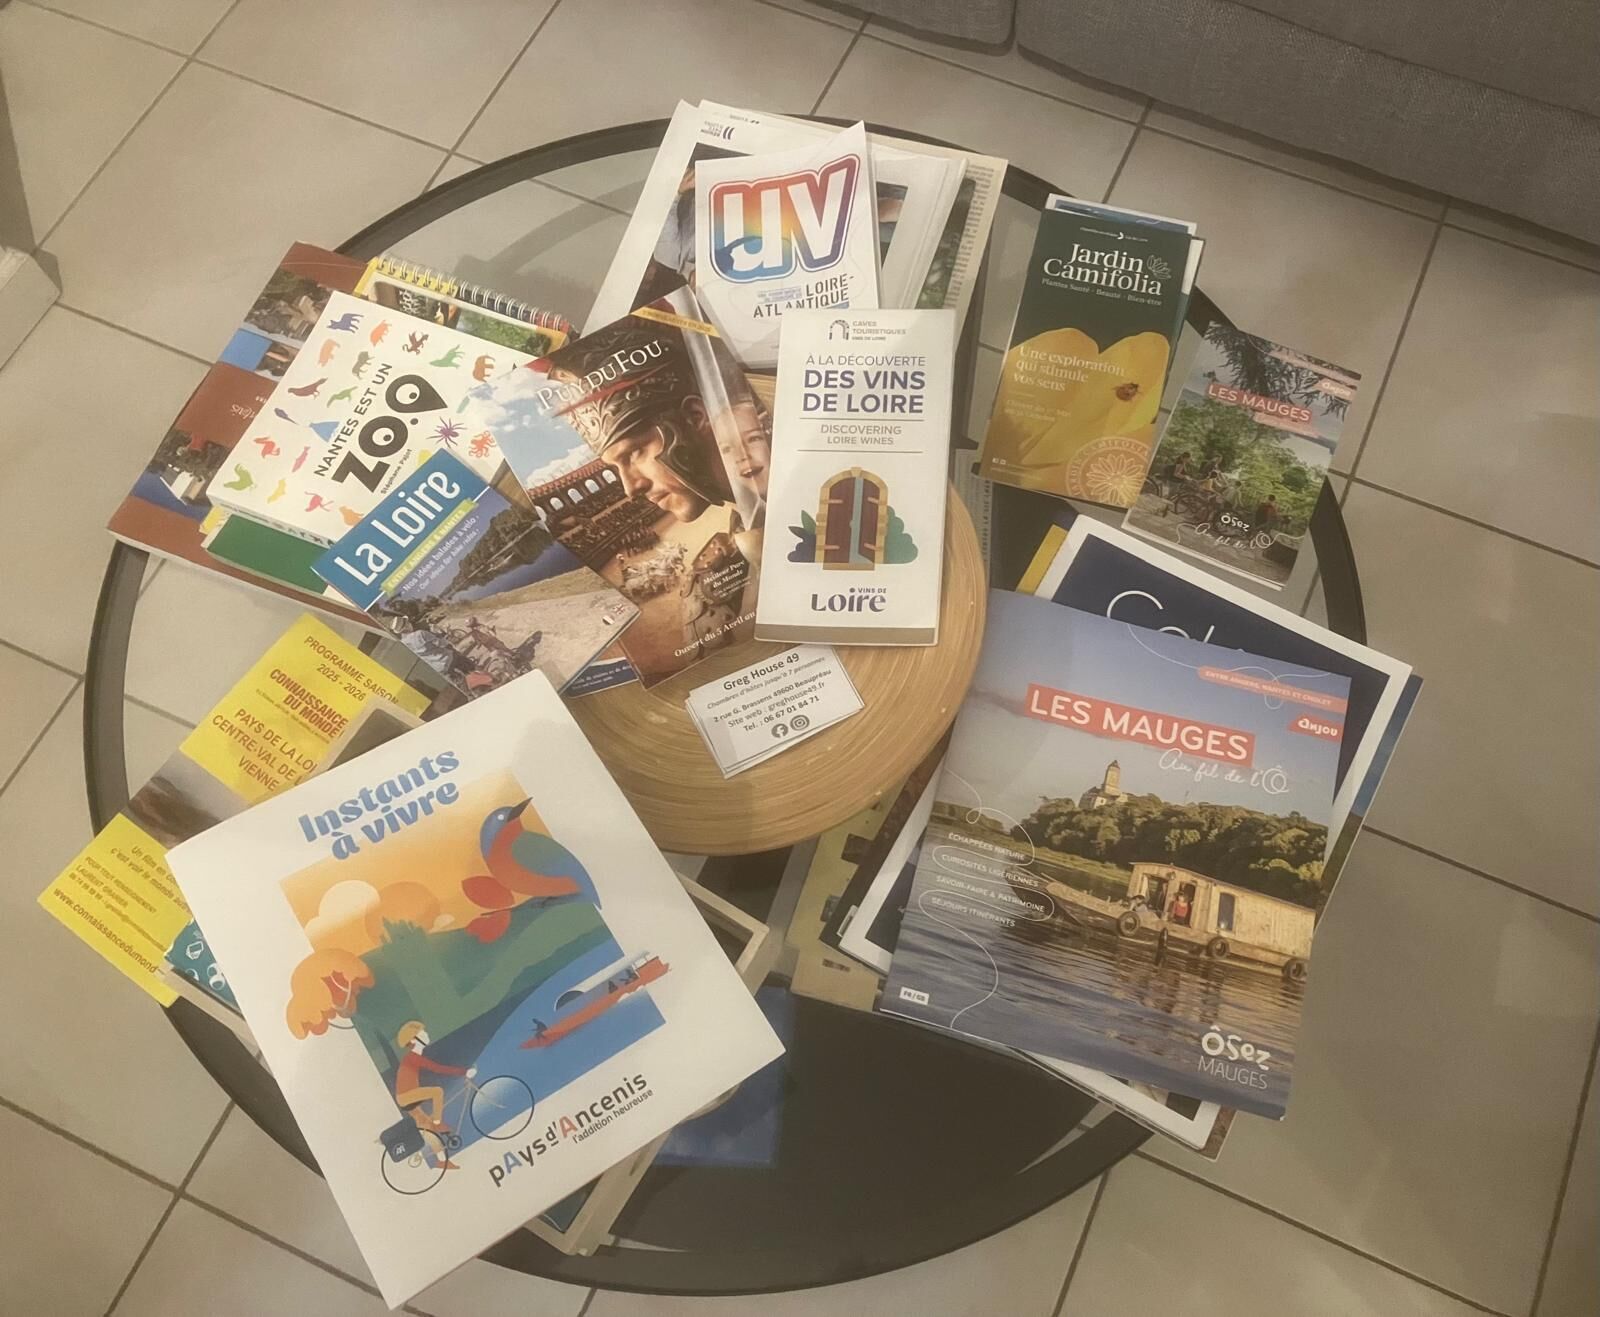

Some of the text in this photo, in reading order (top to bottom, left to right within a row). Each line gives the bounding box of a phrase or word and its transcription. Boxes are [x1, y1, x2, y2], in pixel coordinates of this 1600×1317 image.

[1043, 258, 1162, 296] Camifolia
[1067, 243, 1144, 274] Jardin
[753, 289, 849, 318] ATLANTIQUE
[852, 320, 877, 328] CAVES
[852, 328, 906, 336] TOURISTIQUES
[806, 353, 815, 366] À
[818, 355, 834, 366] LA
[1016, 360, 1089, 383] qui stimule
[1019, 346, 1126, 377] Une exploration
[804, 369, 926, 391] DES VINS
[1013, 373, 1066, 392] vos sens
[314, 363, 393, 477] NANTES EST UN
[803, 393, 924, 413] DE LOIRE
[1208, 384, 1312, 422] LES MAUGES
[820, 424, 902, 435] DISCOVERING
[827, 436, 894, 446] LOIRE WINES
[334, 471, 461, 586] La Loire
[403, 577, 418, 591] Nos
[433, 535, 458, 561] balades
[674, 638, 703, 657] Ouvert
[704, 632, 716, 643] du
[723, 615, 743, 631] Avril
[303, 635, 365, 682] PROGRAMME
[723, 653, 800, 692] Greg House 49
[270, 668, 349, 729] CONNAISSANCE
[316, 663, 366, 702] 2025 2026
[707, 692, 739, 710] Chambres
[793, 656, 826, 675] personnes
[719, 711, 732, 721] rue
[732, 706, 742, 715] G.
[742, 693, 773, 711] Brassens
[773, 684, 795, 697] 49600
[794, 669, 832, 688] Beaupréau
[1264, 681, 1292, 696] NANTES
[282, 693, 300, 713] DU
[727, 681, 825, 728] Site web greghouse49.fr
[743, 722, 758, 732] Tel.
[763, 713, 774, 724] 06
[775, 709, 786, 719] 67
[787, 704, 797, 714] 01
[809, 695, 820, 704] 71
[234, 708, 264, 735] PAYS
[262, 726, 280, 748] DE
[279, 740, 297, 762] LA
[1030, 689, 1250, 760] LES MAUGES
[237, 755, 281, 793] VIENNE
[277, 763, 298, 781] DE
[1194, 760, 1218, 784] fil
[1223, 767, 1249, 790] de
[298, 751, 460, 843] Instants
[331, 782, 459, 860] à vivre
[131, 846, 144, 858] Un
[948, 831, 1026, 861] ÉCHAPPÉES NATURE
[150, 877, 175, 899] monde
[936, 875, 989, 898] SAVOIR-FAIRE
[998, 893, 1046, 913] PATRIMOINE
[53, 887, 163, 974] www.connaissancedumond
[1198, 1055, 1268, 1090] MAUGES
[572, 1089, 653, 1144] l'addition heureuse
